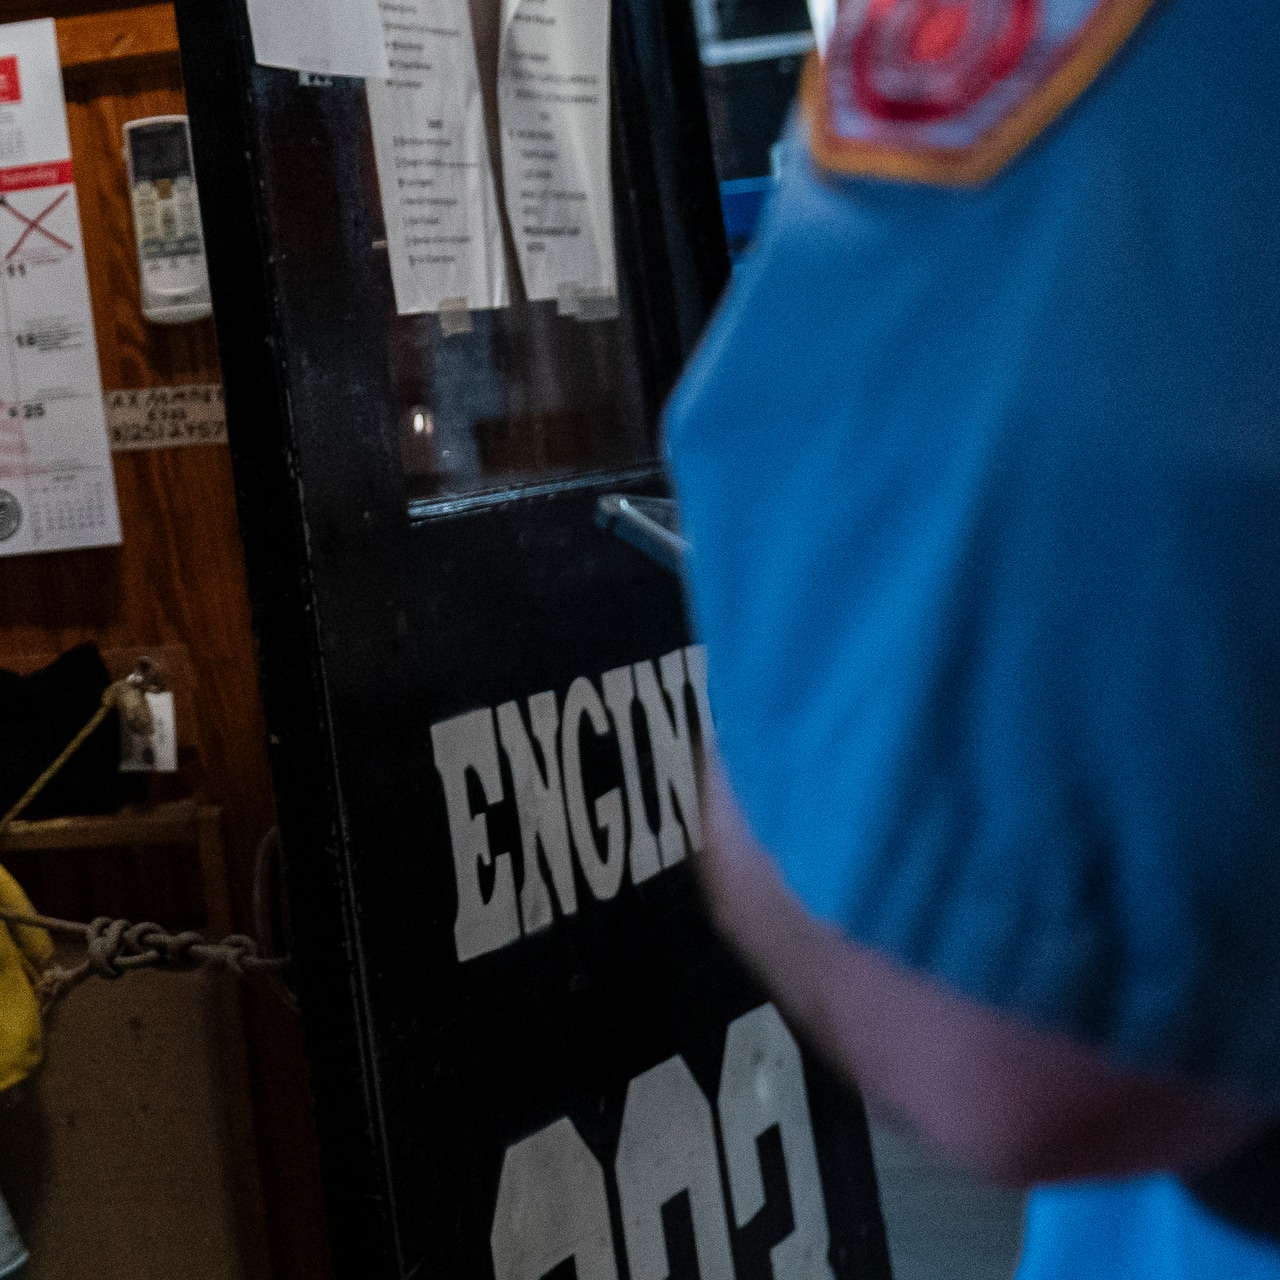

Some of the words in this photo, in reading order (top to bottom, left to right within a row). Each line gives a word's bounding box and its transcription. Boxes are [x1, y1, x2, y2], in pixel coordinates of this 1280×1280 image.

[7, 263, 27, 277] 11
[23, 404, 45, 418] 25
[431, 645, 712, 962] ENGIN
